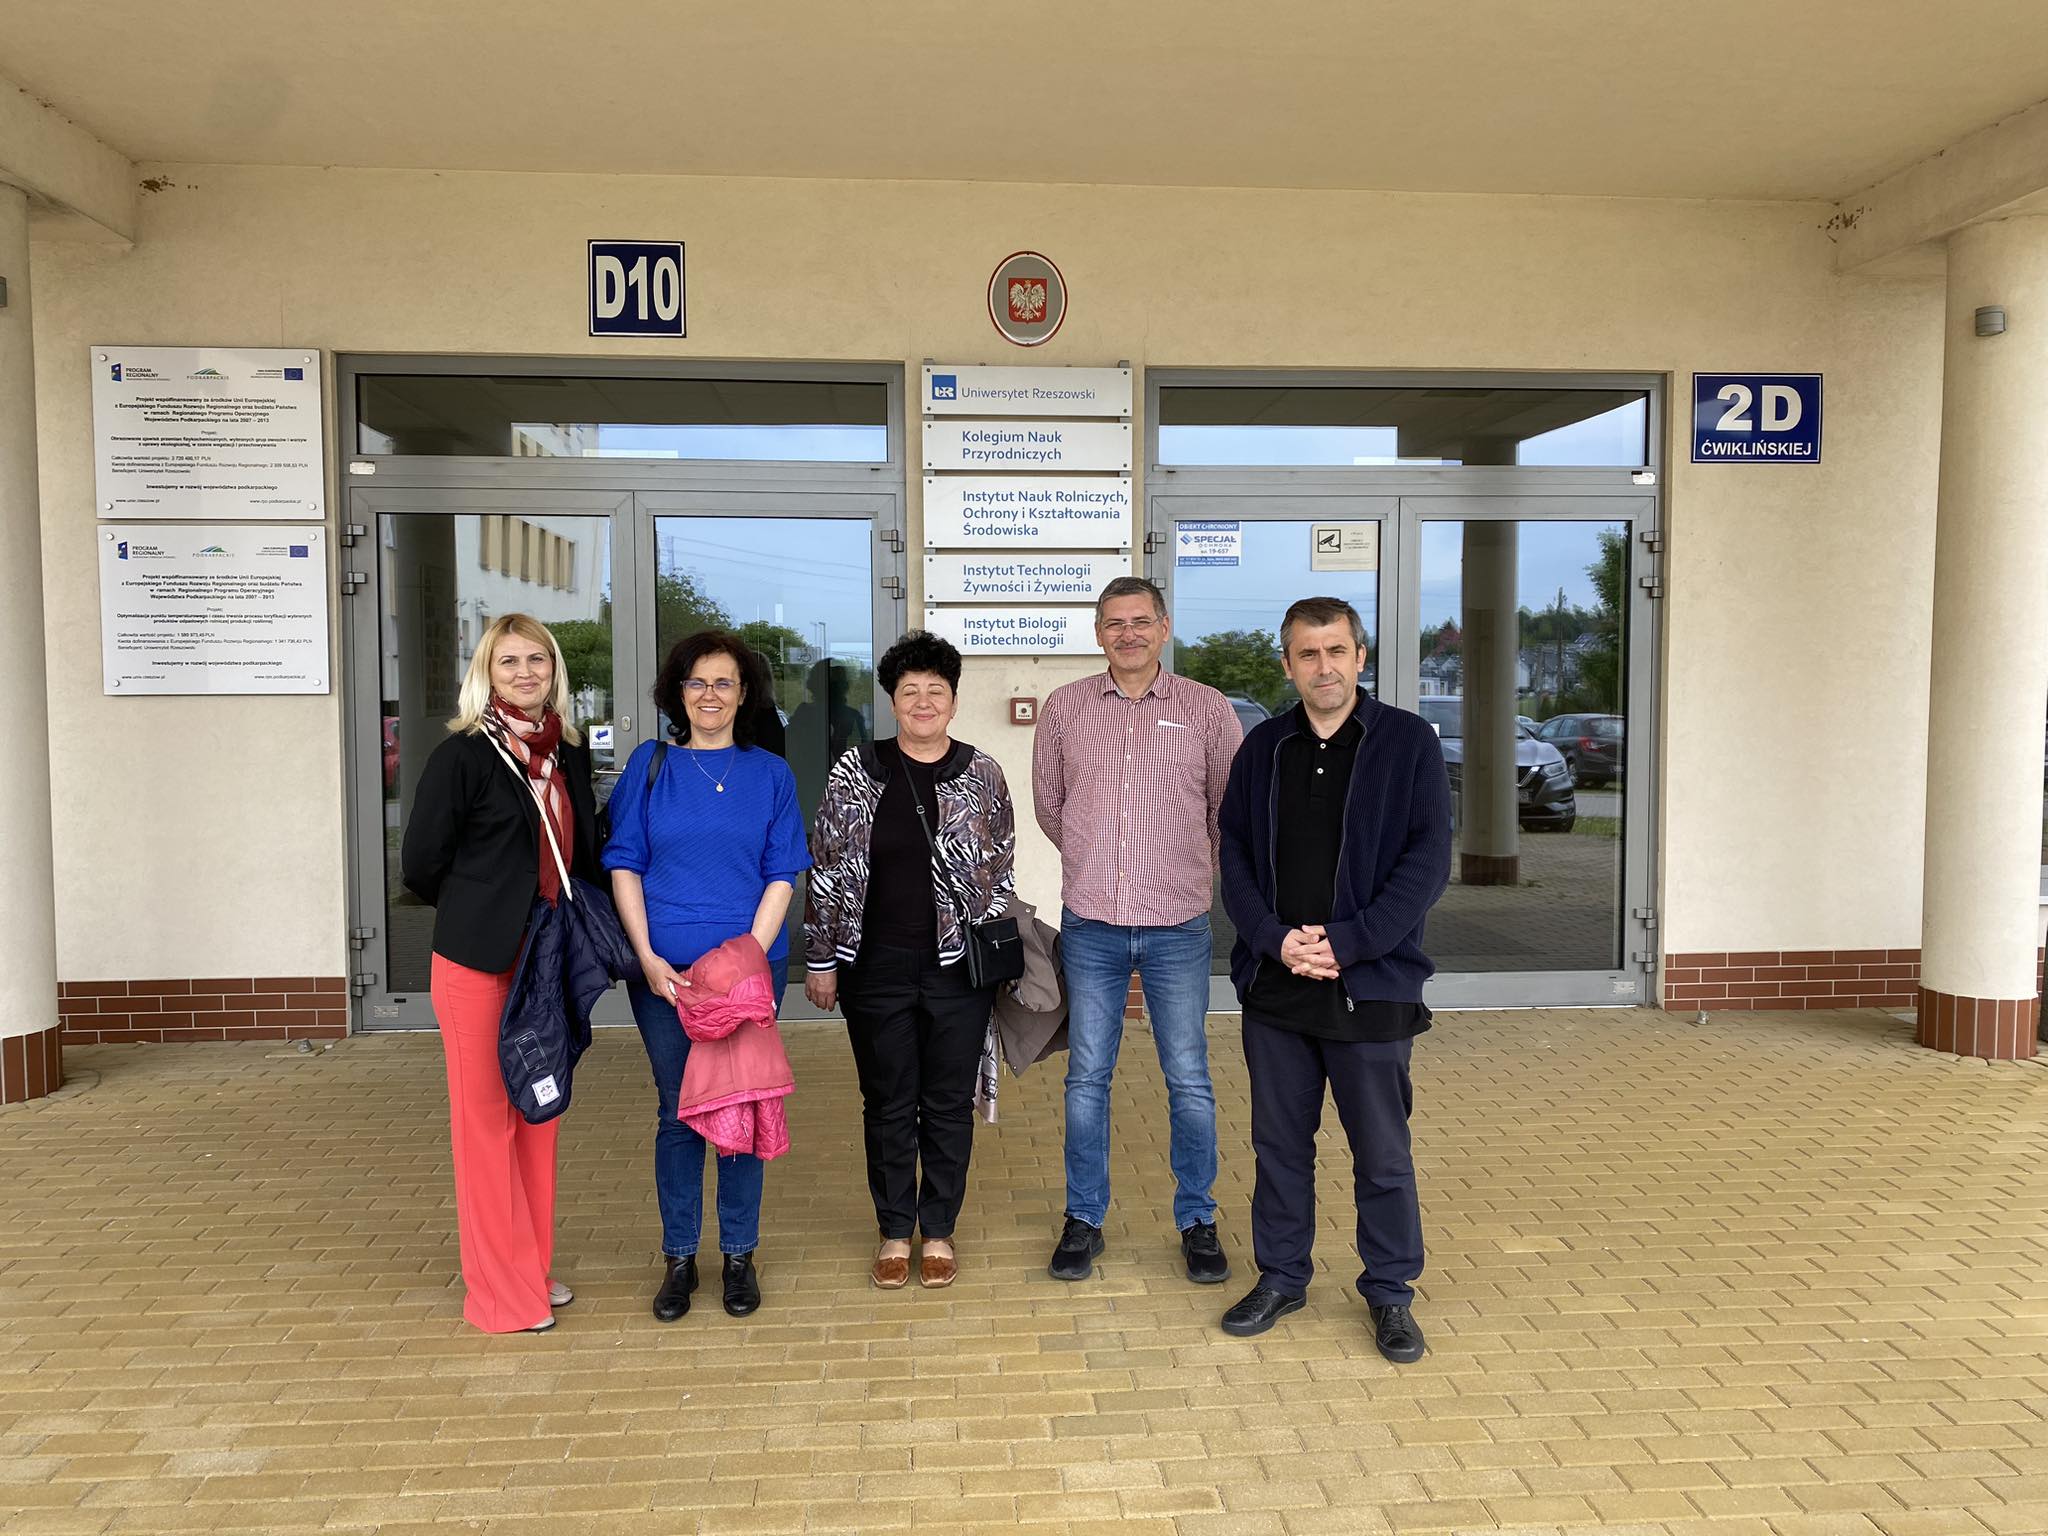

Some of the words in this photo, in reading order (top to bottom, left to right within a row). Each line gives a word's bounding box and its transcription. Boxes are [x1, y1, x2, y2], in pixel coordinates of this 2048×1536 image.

[596, 256, 680, 320] D10
[962, 388, 1028, 399] Uniwersytet
[1032, 388, 1095, 399] Rzeszowski
[1715, 384, 1802, 432] 2D
[962, 432, 1024, 444] Kolegium
[1028, 432, 1062, 442] Nauk
[962, 448, 1061, 460] Przyrodniczych
[1701, 440, 1812, 456] ĆWIKLIŃSKIEJ
[963, 491, 1014, 505] Instytut
[1018, 491, 1052, 502] Nauk
[1056, 491, 1128, 505] Rolniczych,
[964, 508, 1018, 520] Ochrony
[1022, 508, 1025, 518] i
[1029, 508, 1120, 518] Kształtowania
[963, 523, 1038, 536] Środowiska
[964, 565, 1014, 577] Instytut
[1017, 565, 1090, 577] Technologii
[964, 581, 1025, 593] Żywności
[1028, 582, 1030, 592] i
[1034, 581, 1092, 593] Żywienia
[964, 618, 1014, 630] Instytut
[1019, 618, 1066, 630] Biologii
[964, 635, 967, 645] i
[971, 635, 1064, 647] Biotechnologii
